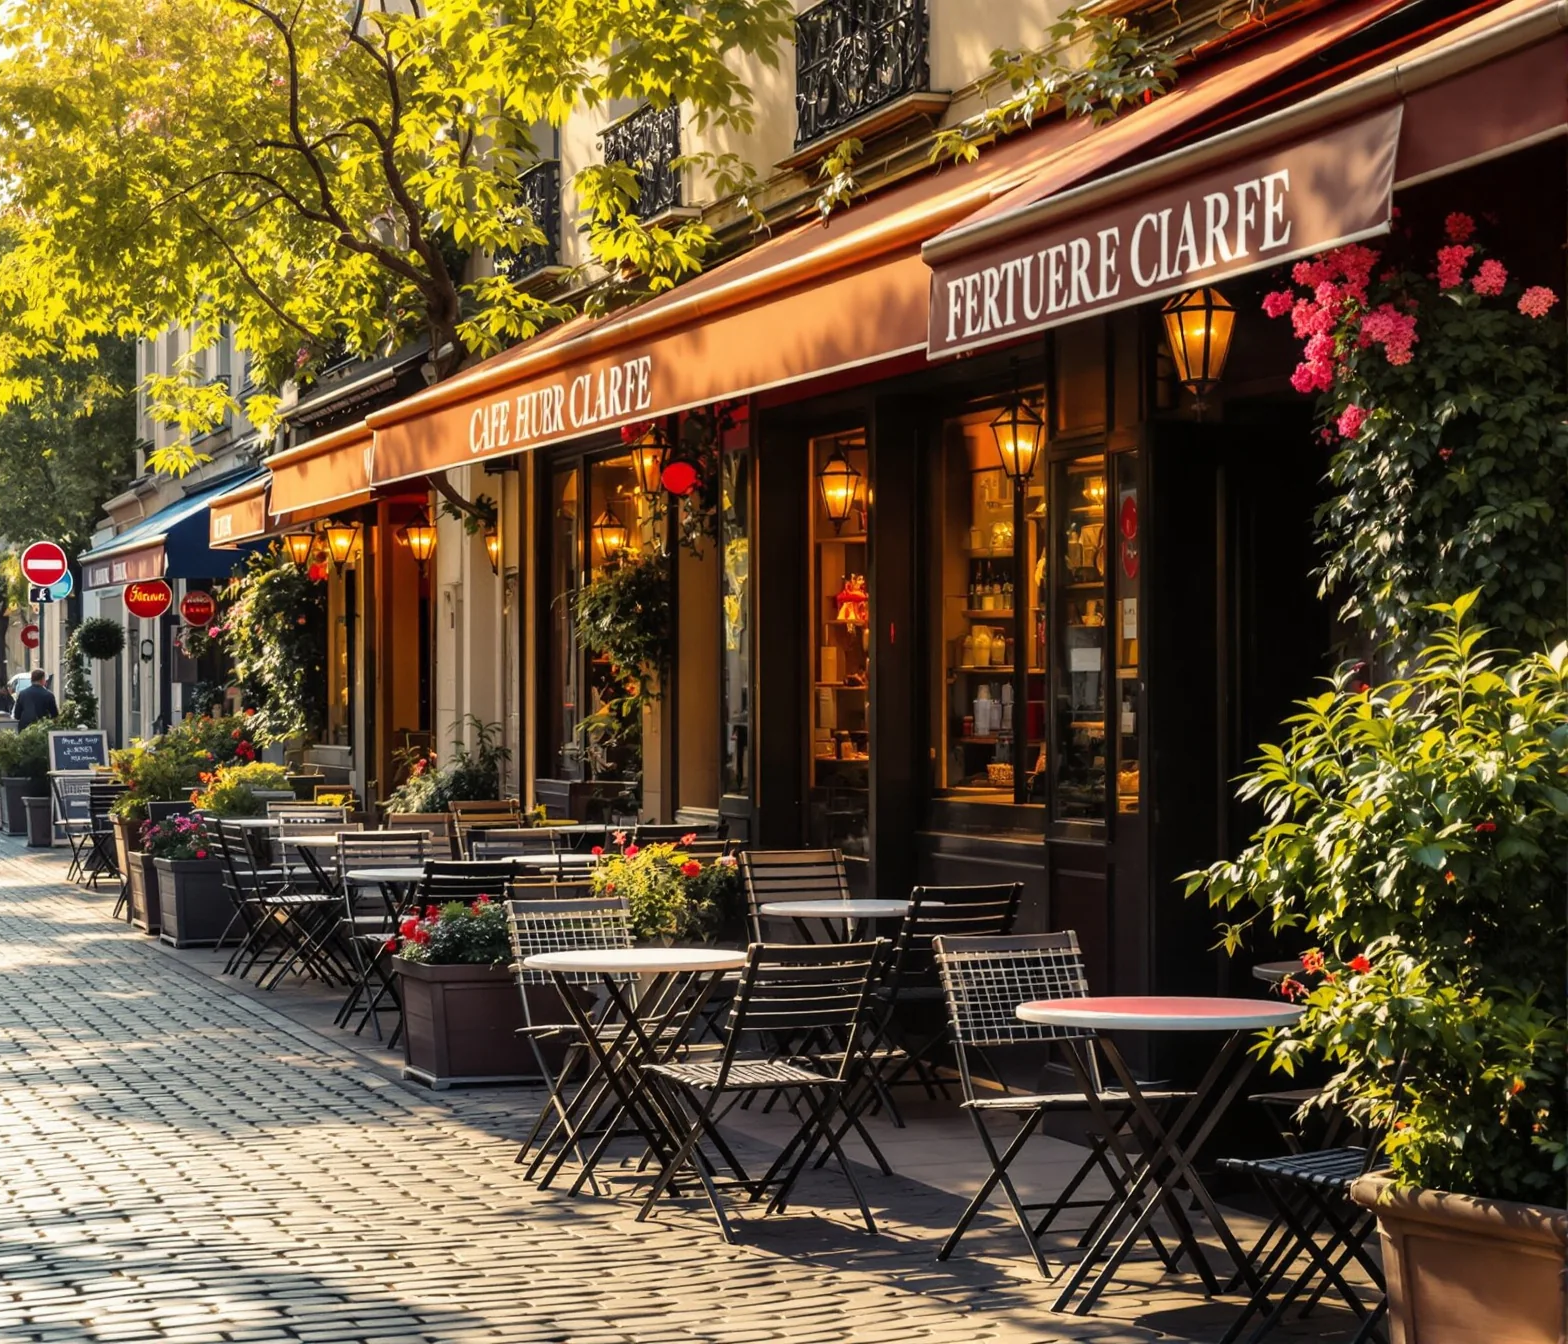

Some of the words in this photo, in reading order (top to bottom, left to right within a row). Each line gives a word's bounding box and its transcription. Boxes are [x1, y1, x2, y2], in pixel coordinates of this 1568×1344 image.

[945, 226, 1121, 343] FERTUERE
[469, 400, 510, 454] CAFE
[569, 355, 652, 429] CLARFE
